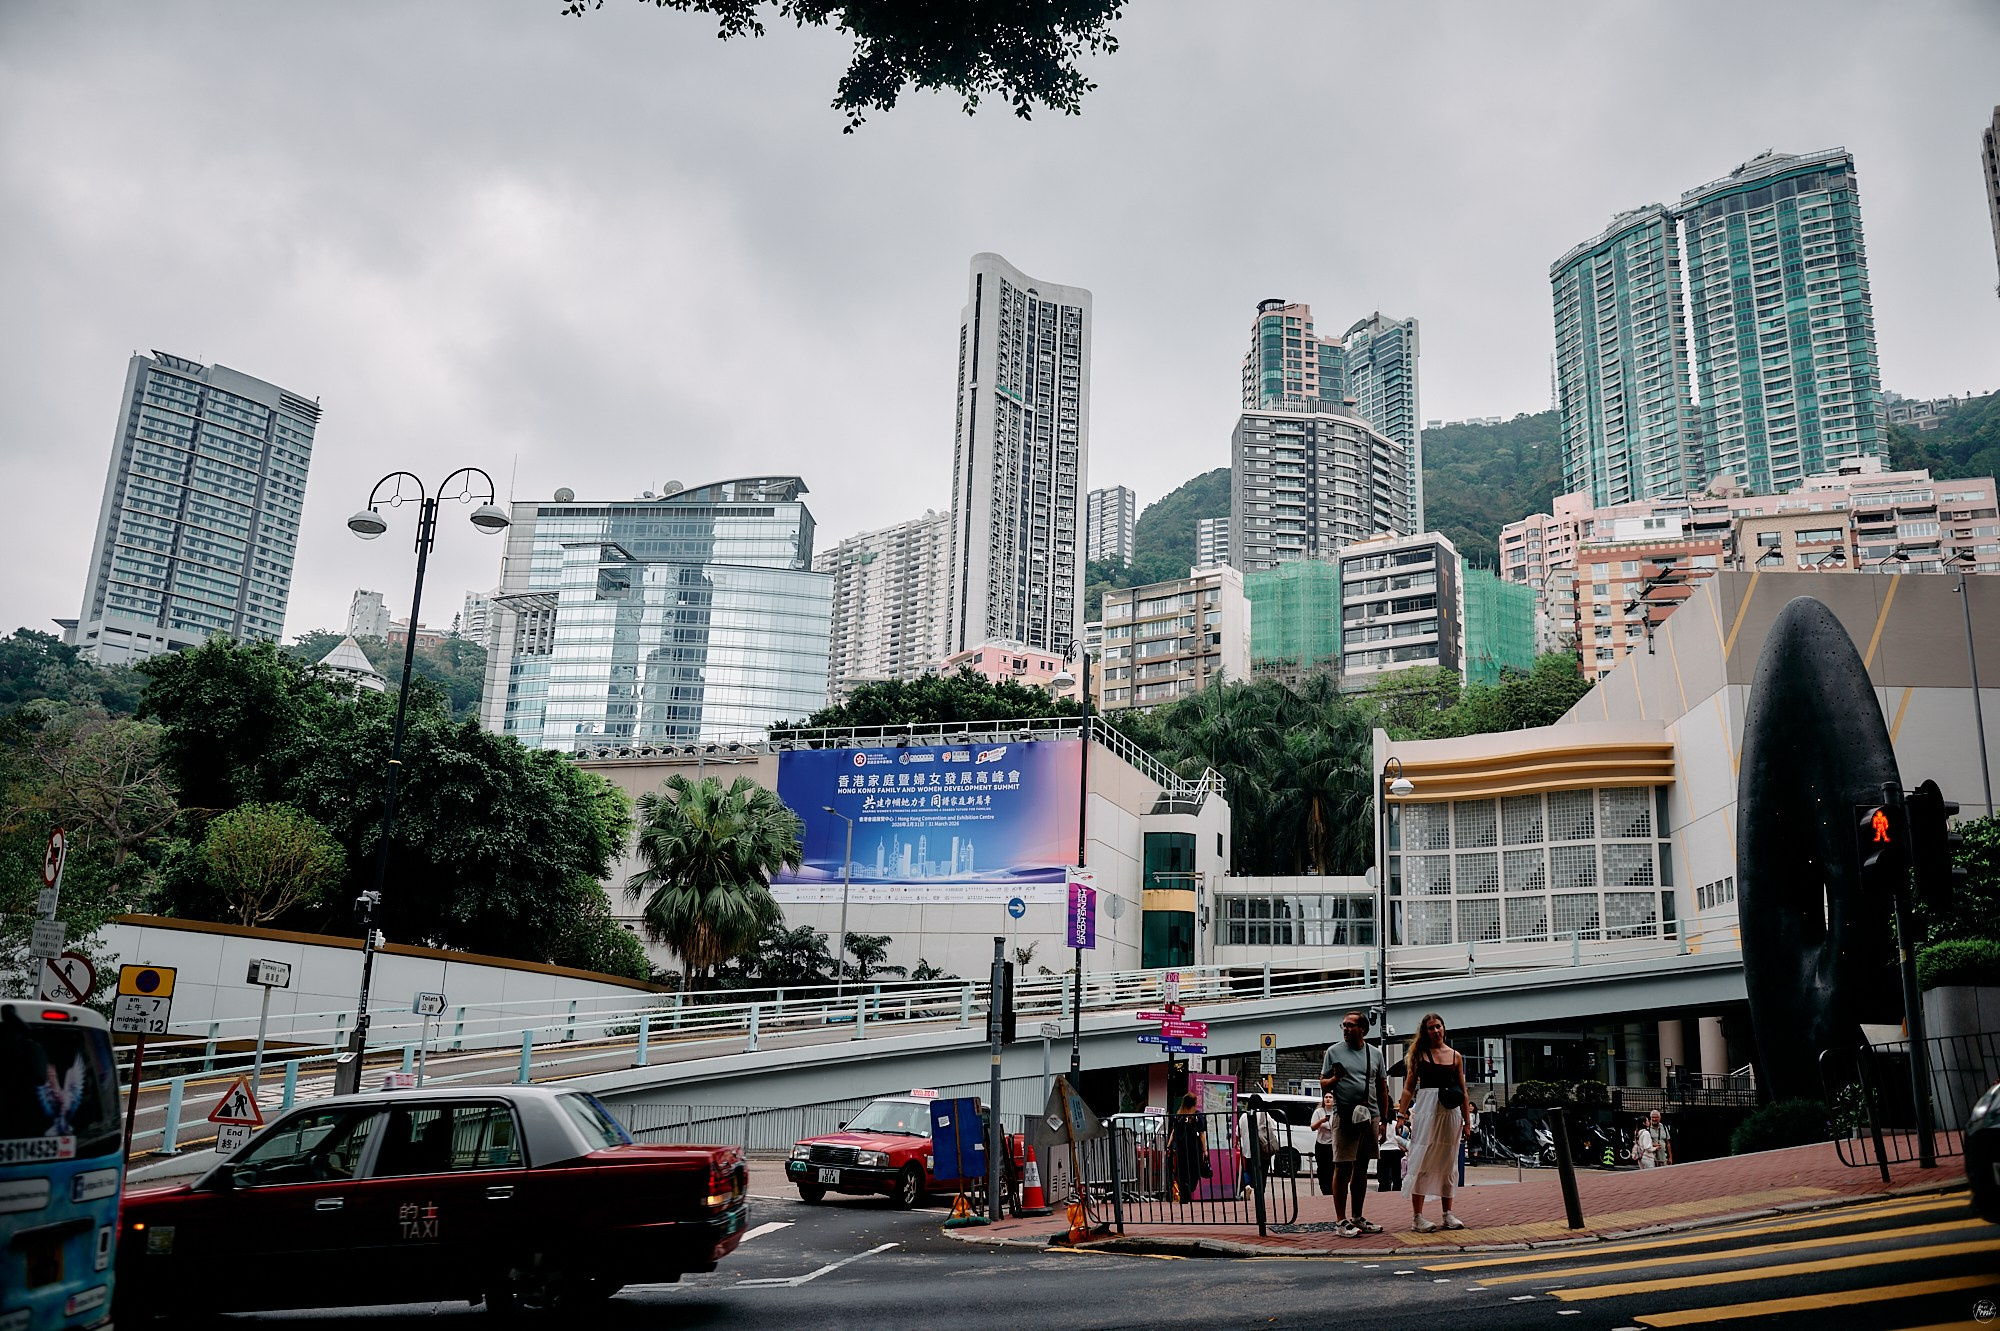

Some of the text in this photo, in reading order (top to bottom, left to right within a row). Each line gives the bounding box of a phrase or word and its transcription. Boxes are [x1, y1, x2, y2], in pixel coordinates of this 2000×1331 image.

[838, 769, 1020, 787] 香港家庭暨婦女發展高峰會
[125, 1003, 142, 1011] 上午
[152, 999, 161, 1012] 7
[116, 1016, 147, 1024] midnight
[149, 1019, 164, 1032] 12
[226, 1128, 243, 1137] End
[824, 1169, 834, 1177] UX
[821, 1175, 836, 1183] 1814
[399, 1201, 440, 1219] 的士
[399, 1219, 440, 1240] TAXI
